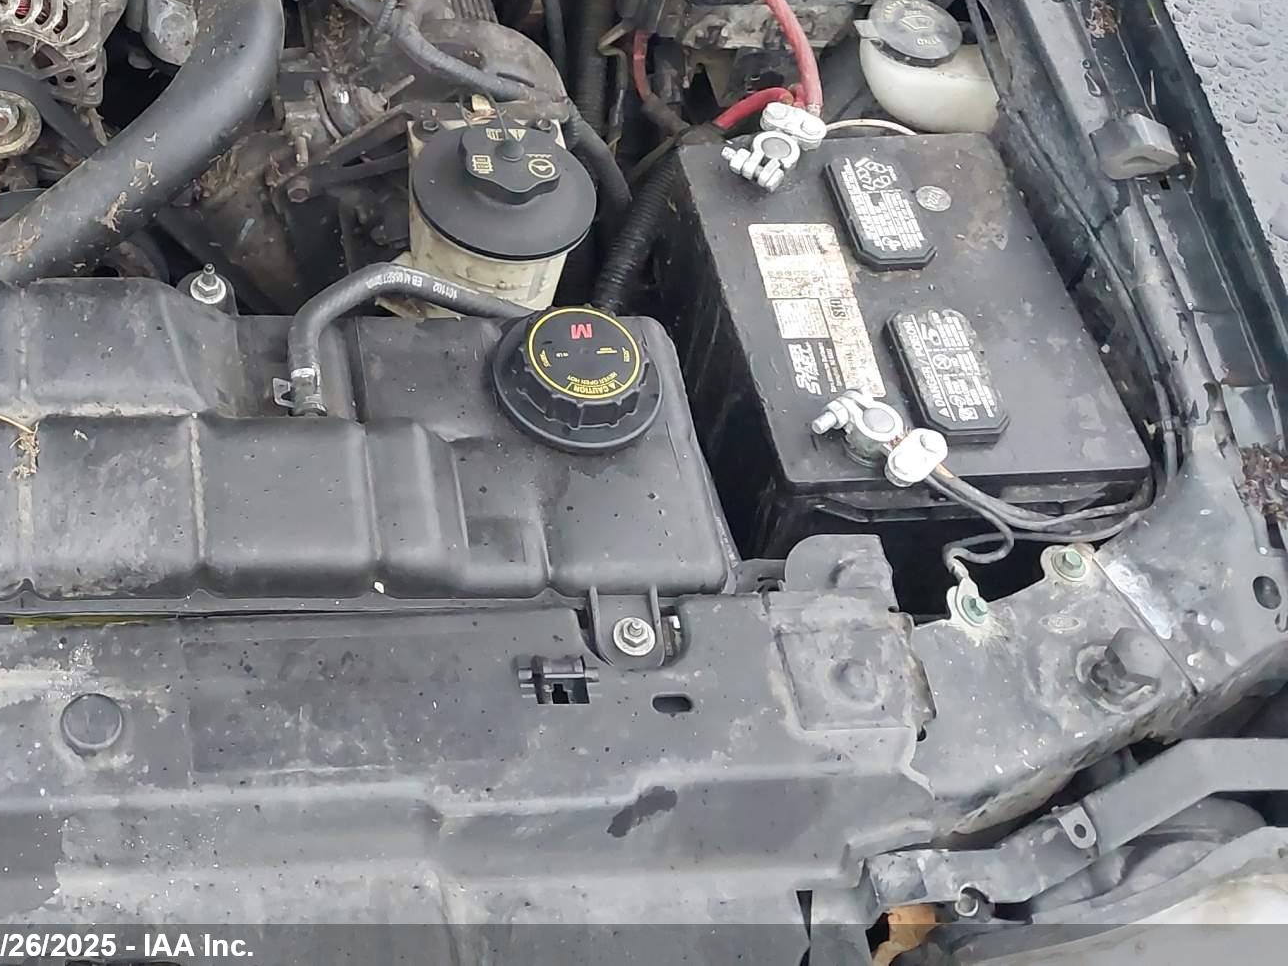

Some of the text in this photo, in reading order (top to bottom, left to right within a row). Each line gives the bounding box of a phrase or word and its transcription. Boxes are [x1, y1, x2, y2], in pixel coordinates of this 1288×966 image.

[903, 321, 925, 357] POISON
[599, 371, 618, 384] NEVER
[787, 344, 806, 387] SUPER
[573, 384, 609, 395] CAUTION
[921, 366, 946, 407] DANGER
